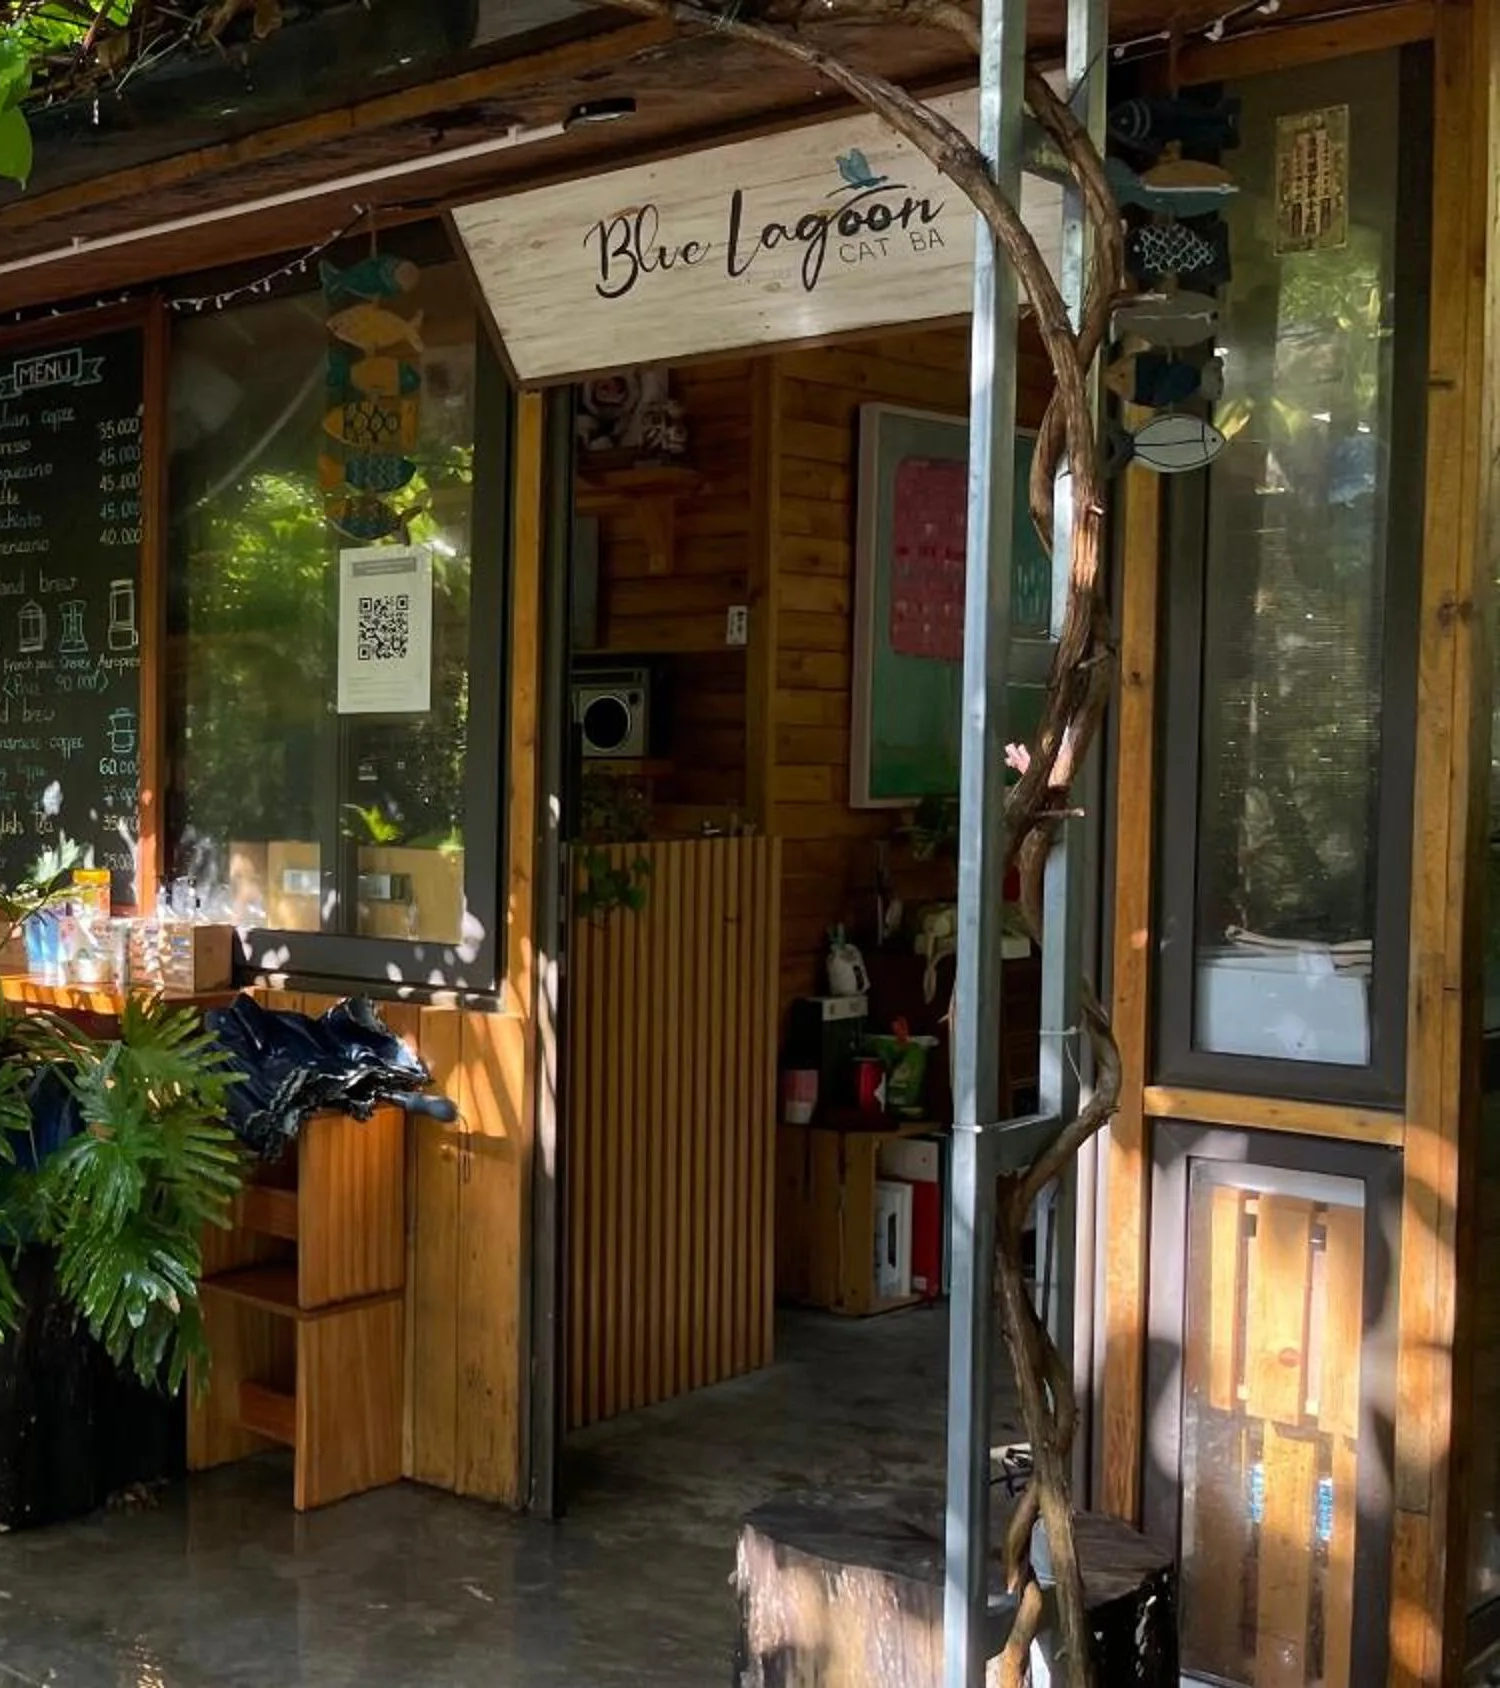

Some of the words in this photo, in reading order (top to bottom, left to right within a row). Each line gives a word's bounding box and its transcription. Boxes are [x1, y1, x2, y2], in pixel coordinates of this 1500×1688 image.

[583, 204, 711, 298] Blue
[726, 188, 945, 292] Lagoon
[840, 239, 890, 264] CAT
[911, 229, 945, 253] BA
[19, 358, 71, 385] MENU
[98, 527, 142, 546] 40.000
